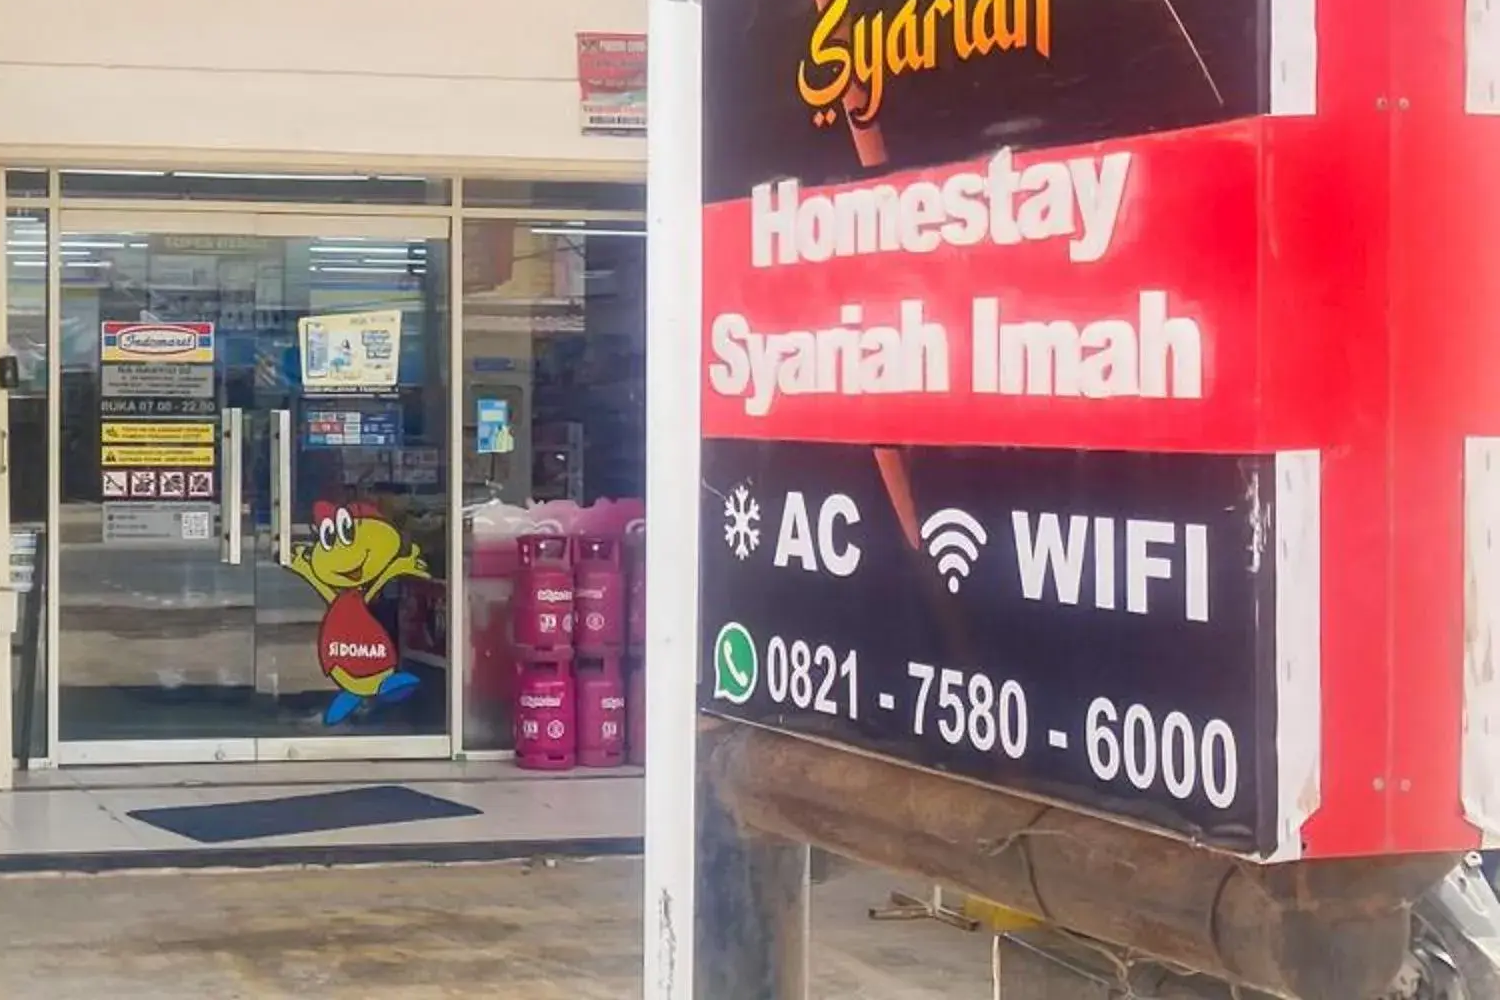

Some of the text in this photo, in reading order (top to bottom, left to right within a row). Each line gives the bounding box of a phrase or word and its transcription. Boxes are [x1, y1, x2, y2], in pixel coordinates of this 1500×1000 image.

[751, 146, 1132, 268] Homestay
[710, 289, 1203, 416] Syariah Imah
[774, 491, 1209, 622] AC WIFI
[766, 636, 860, 720] 0821
[907, 662, 1028, 760] 7580
[1085, 697, 1238, 809] 6000
